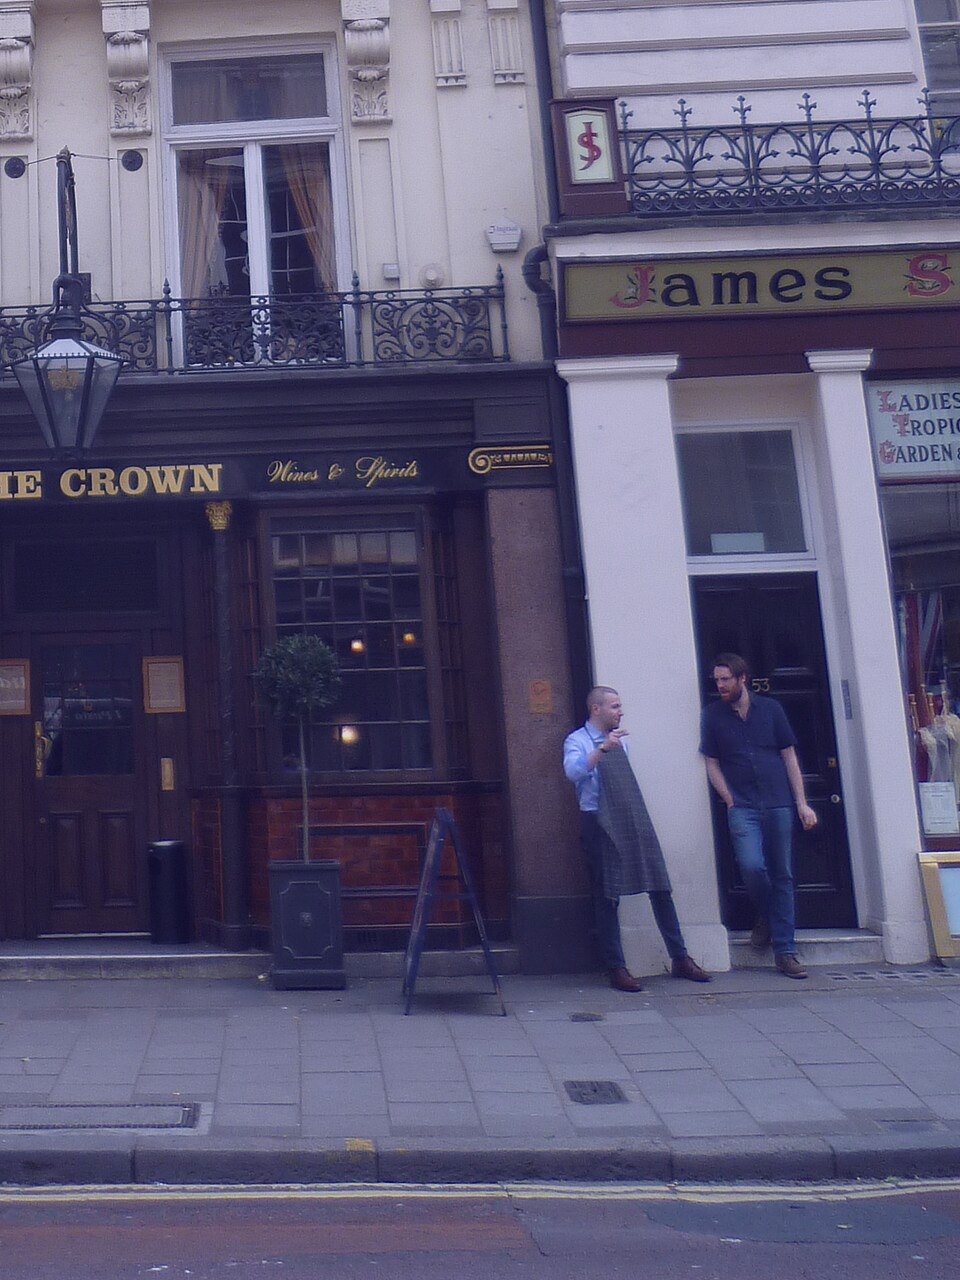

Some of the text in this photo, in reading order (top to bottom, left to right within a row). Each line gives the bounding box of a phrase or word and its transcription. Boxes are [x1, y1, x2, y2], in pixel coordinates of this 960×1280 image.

[608, 266, 853, 309] James
[879, 440, 953, 464] GARDEN
[59, 463, 223, 499] CROWN
[266, 456, 419, 488] Wines & Spirits
[752, 678, 770, 692] 53
